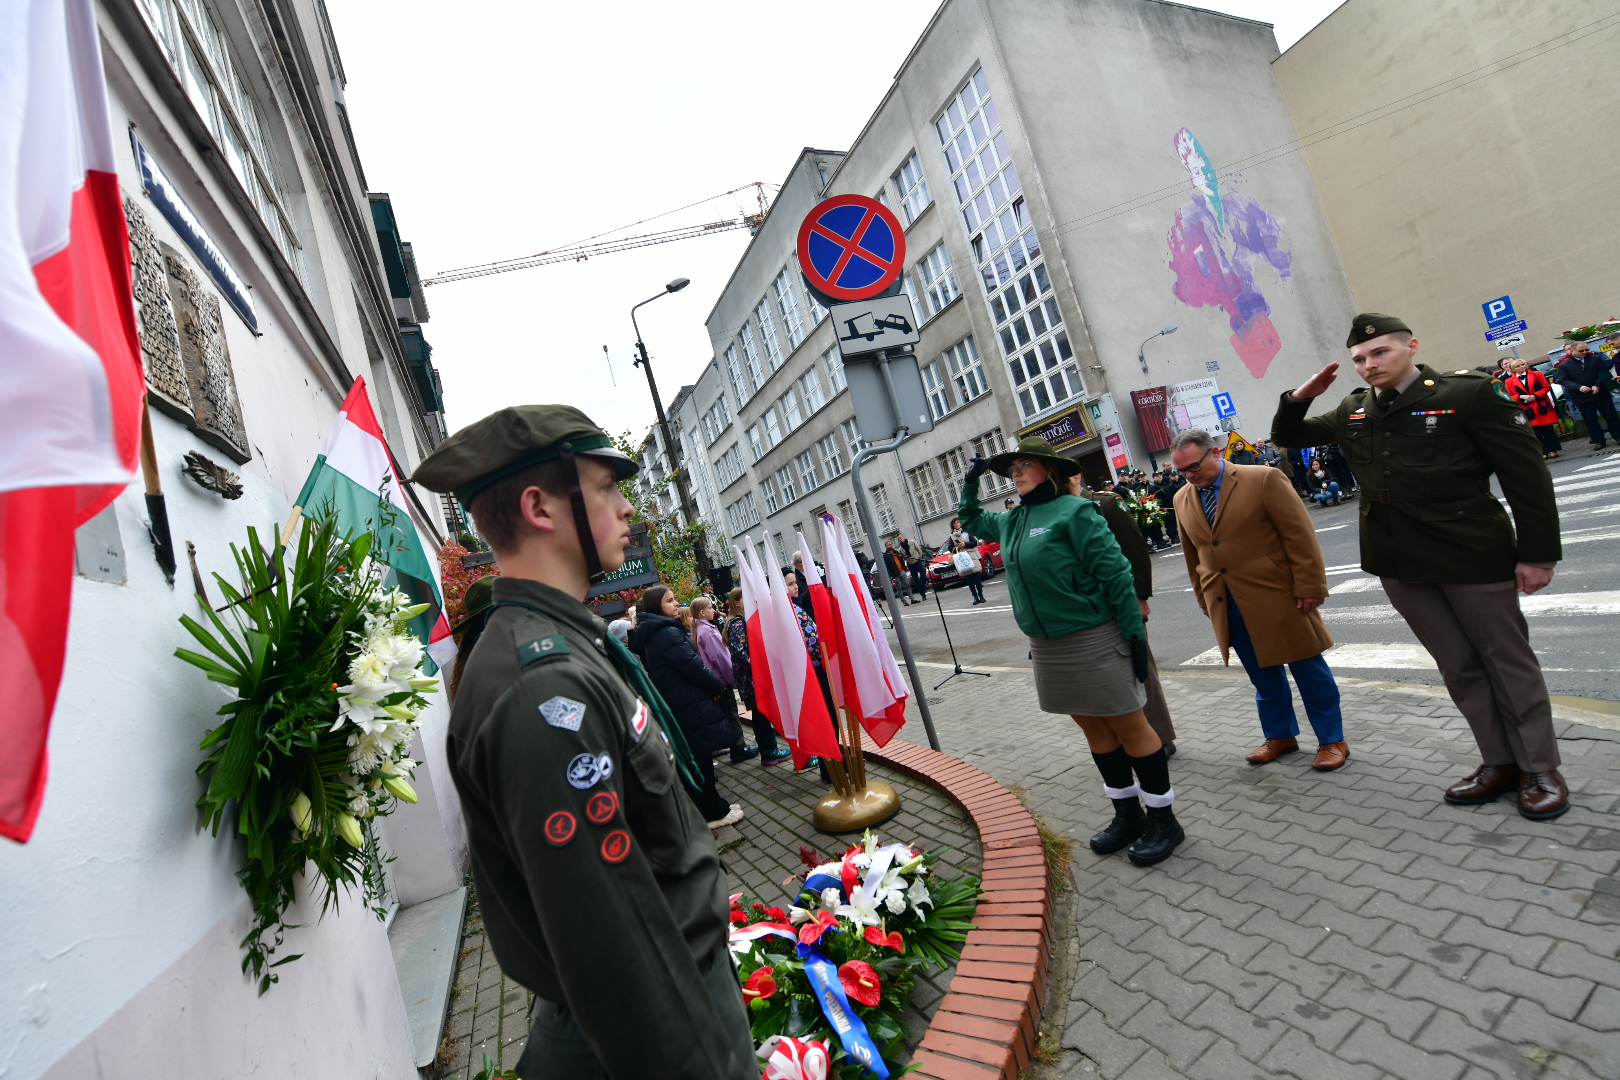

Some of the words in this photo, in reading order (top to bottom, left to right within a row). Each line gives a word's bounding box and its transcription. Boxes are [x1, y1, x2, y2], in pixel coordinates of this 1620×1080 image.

[1489, 300, 1506, 319] P
[1094, 405, 1101, 418] A
[1217, 396, 1230, 416] P
[529, 638, 554, 653] 15
[823, 989, 852, 1034] POZNANIA
